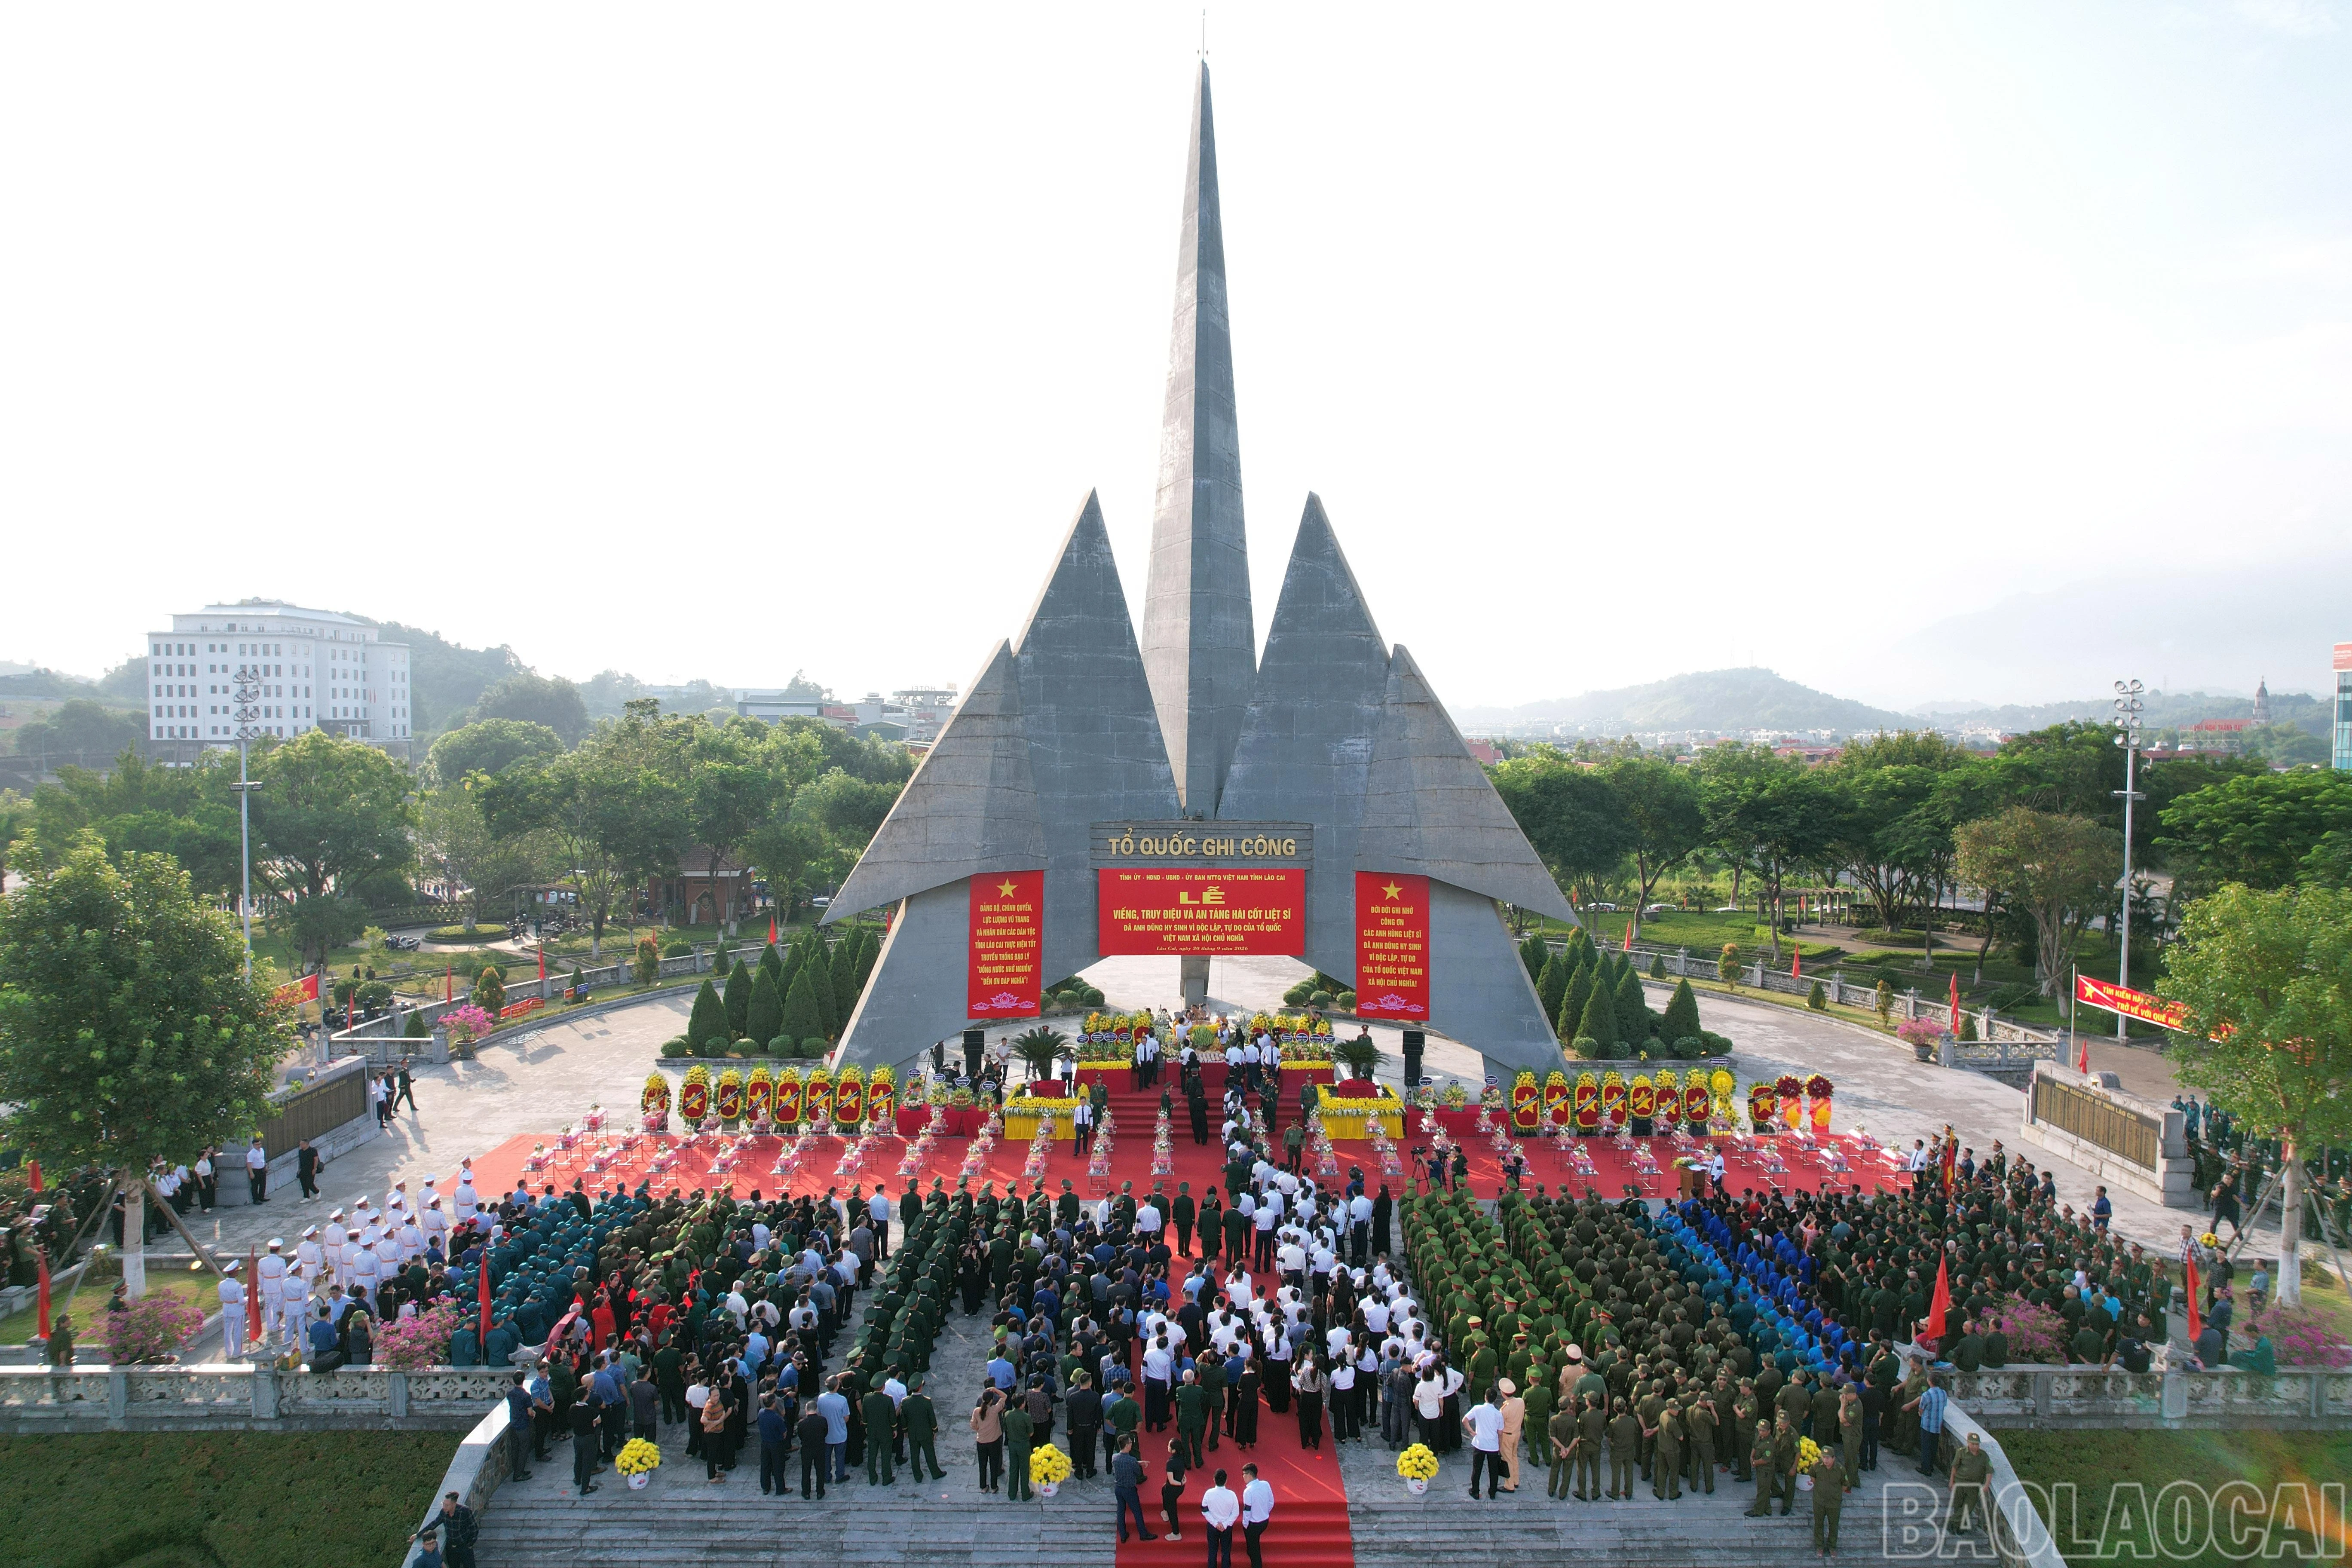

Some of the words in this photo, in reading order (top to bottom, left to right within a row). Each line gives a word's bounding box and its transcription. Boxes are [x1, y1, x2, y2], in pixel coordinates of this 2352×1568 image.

[1108, 827, 1134, 855] TỔ
[1140, 830, 1196, 856] QUỐC
[1202, 838, 1234, 856] GHI
[1241, 834, 1295, 856] CÔNG
[1223, 873, 1235, 882] VIỆT
[1179, 886, 1225, 904] LỄ
[980, 902, 992, 912] ĐẢNG
[1002, 903, 1016, 912] CHÍNH
[1371, 905, 1380, 913] ĐỜI
[1381, 905, 1390, 914] ĐỜI
[1402, 906, 1414, 914] NHỚ
[1113, 906, 1139, 921] VIẾNG,
[1141, 910, 1161, 919] TRUY
[1163, 907, 1181, 921] ĐIỆU
[1183, 907, 1194, 919] VÀ
[1195, 910, 1207, 919] AN
[1209, 907, 1230, 919] TÁNG
[1232, 908, 1245, 919] HÀI
[1247, 906, 1264, 920] CỐT
[1265, 907, 1281, 922] LIỆT
[1283, 908, 1291, 919] SĨ
[983, 916, 992, 925] LỰC
[1008, 915, 1014, 923] VŨ
[1381, 917, 1395, 925] CÔNG
[976, 928, 983, 936] VÀ
[983, 928, 996, 936] NHÂN
[1007, 927, 1016, 936] CÁC
[1027, 927, 1035, 937] TỘC
[1124, 923, 1132, 931] ĐÃ
[1147, 923, 1163, 931] DŨNG
[1189, 923, 1195, 931] VÌ
[1196, 923, 1208, 932] ĐỘC
[1210, 923, 1222, 933] LẬP,
[1224, 923, 1233, 932] TỰ
[1243, 922, 1255, 931] CỦA
[1256, 921, 1265, 931] TỔ
[1265, 922, 1281, 932] QUỐC
[1163, 933, 1176, 943] VIỆT
[1192, 933, 1200, 941] XÃ
[1201, 933, 1212, 943] HỘI
[1213, 932, 1225, 942] CHỦ
[1226, 934, 1244, 942] NGHĨA
[1363, 928, 1374, 937] CÁC
[1387, 929, 1403, 937] HÙNG
[1403, 930, 1415, 939] LIỆT
[1415, 930, 1421, 938] SĨ
[975, 940, 986, 949] TỈNH
[986, 940, 995, 949] LÀO
[1004, 940, 1016, 949] THỰC
[1017, 940, 1027, 949] HIỆN
[1028, 938, 1036, 948] TỐT
[1363, 940, 1371, 949] ĐÃ
[1384, 941, 1399, 949] DŨNG
[998, 952, 1014, 961] THỐNG
[1014, 953, 1023, 962] ĐẠO
[1024, 952, 1029, 960] LÝ
[1369, 952, 1375, 961] VÌ
[1375, 952, 1386, 962] ĐỘC
[1387, 953, 1399, 963] LẬP,
[1400, 954, 1408, 963] TỰ
[992, 964, 1004, 973] NƯỚC
[1005, 964, 1015, 973] NHỚ
[1363, 963, 1373, 973] CỦA
[1374, 964, 1381, 974] TỔ
[1382, 965, 1396, 974] QUỐC
[1397, 966, 1409, 976] VIỆT
[1368, 977, 1375, 986] XÃ
[1376, 977, 1385, 987] HỘI
[1387, 977, 1397, 986] CHỦ
[1398, 979, 1417, 987] NGHĨA!
[2103, 986, 2114, 995] TÌM
[2115, 990, 2131, 1001] KIẾM
[2116, 1001, 2129, 1012] TRỞ
[2140, 1009, 2151, 1019] VỚI
[2153, 1013, 2167, 1023] QUÊ
